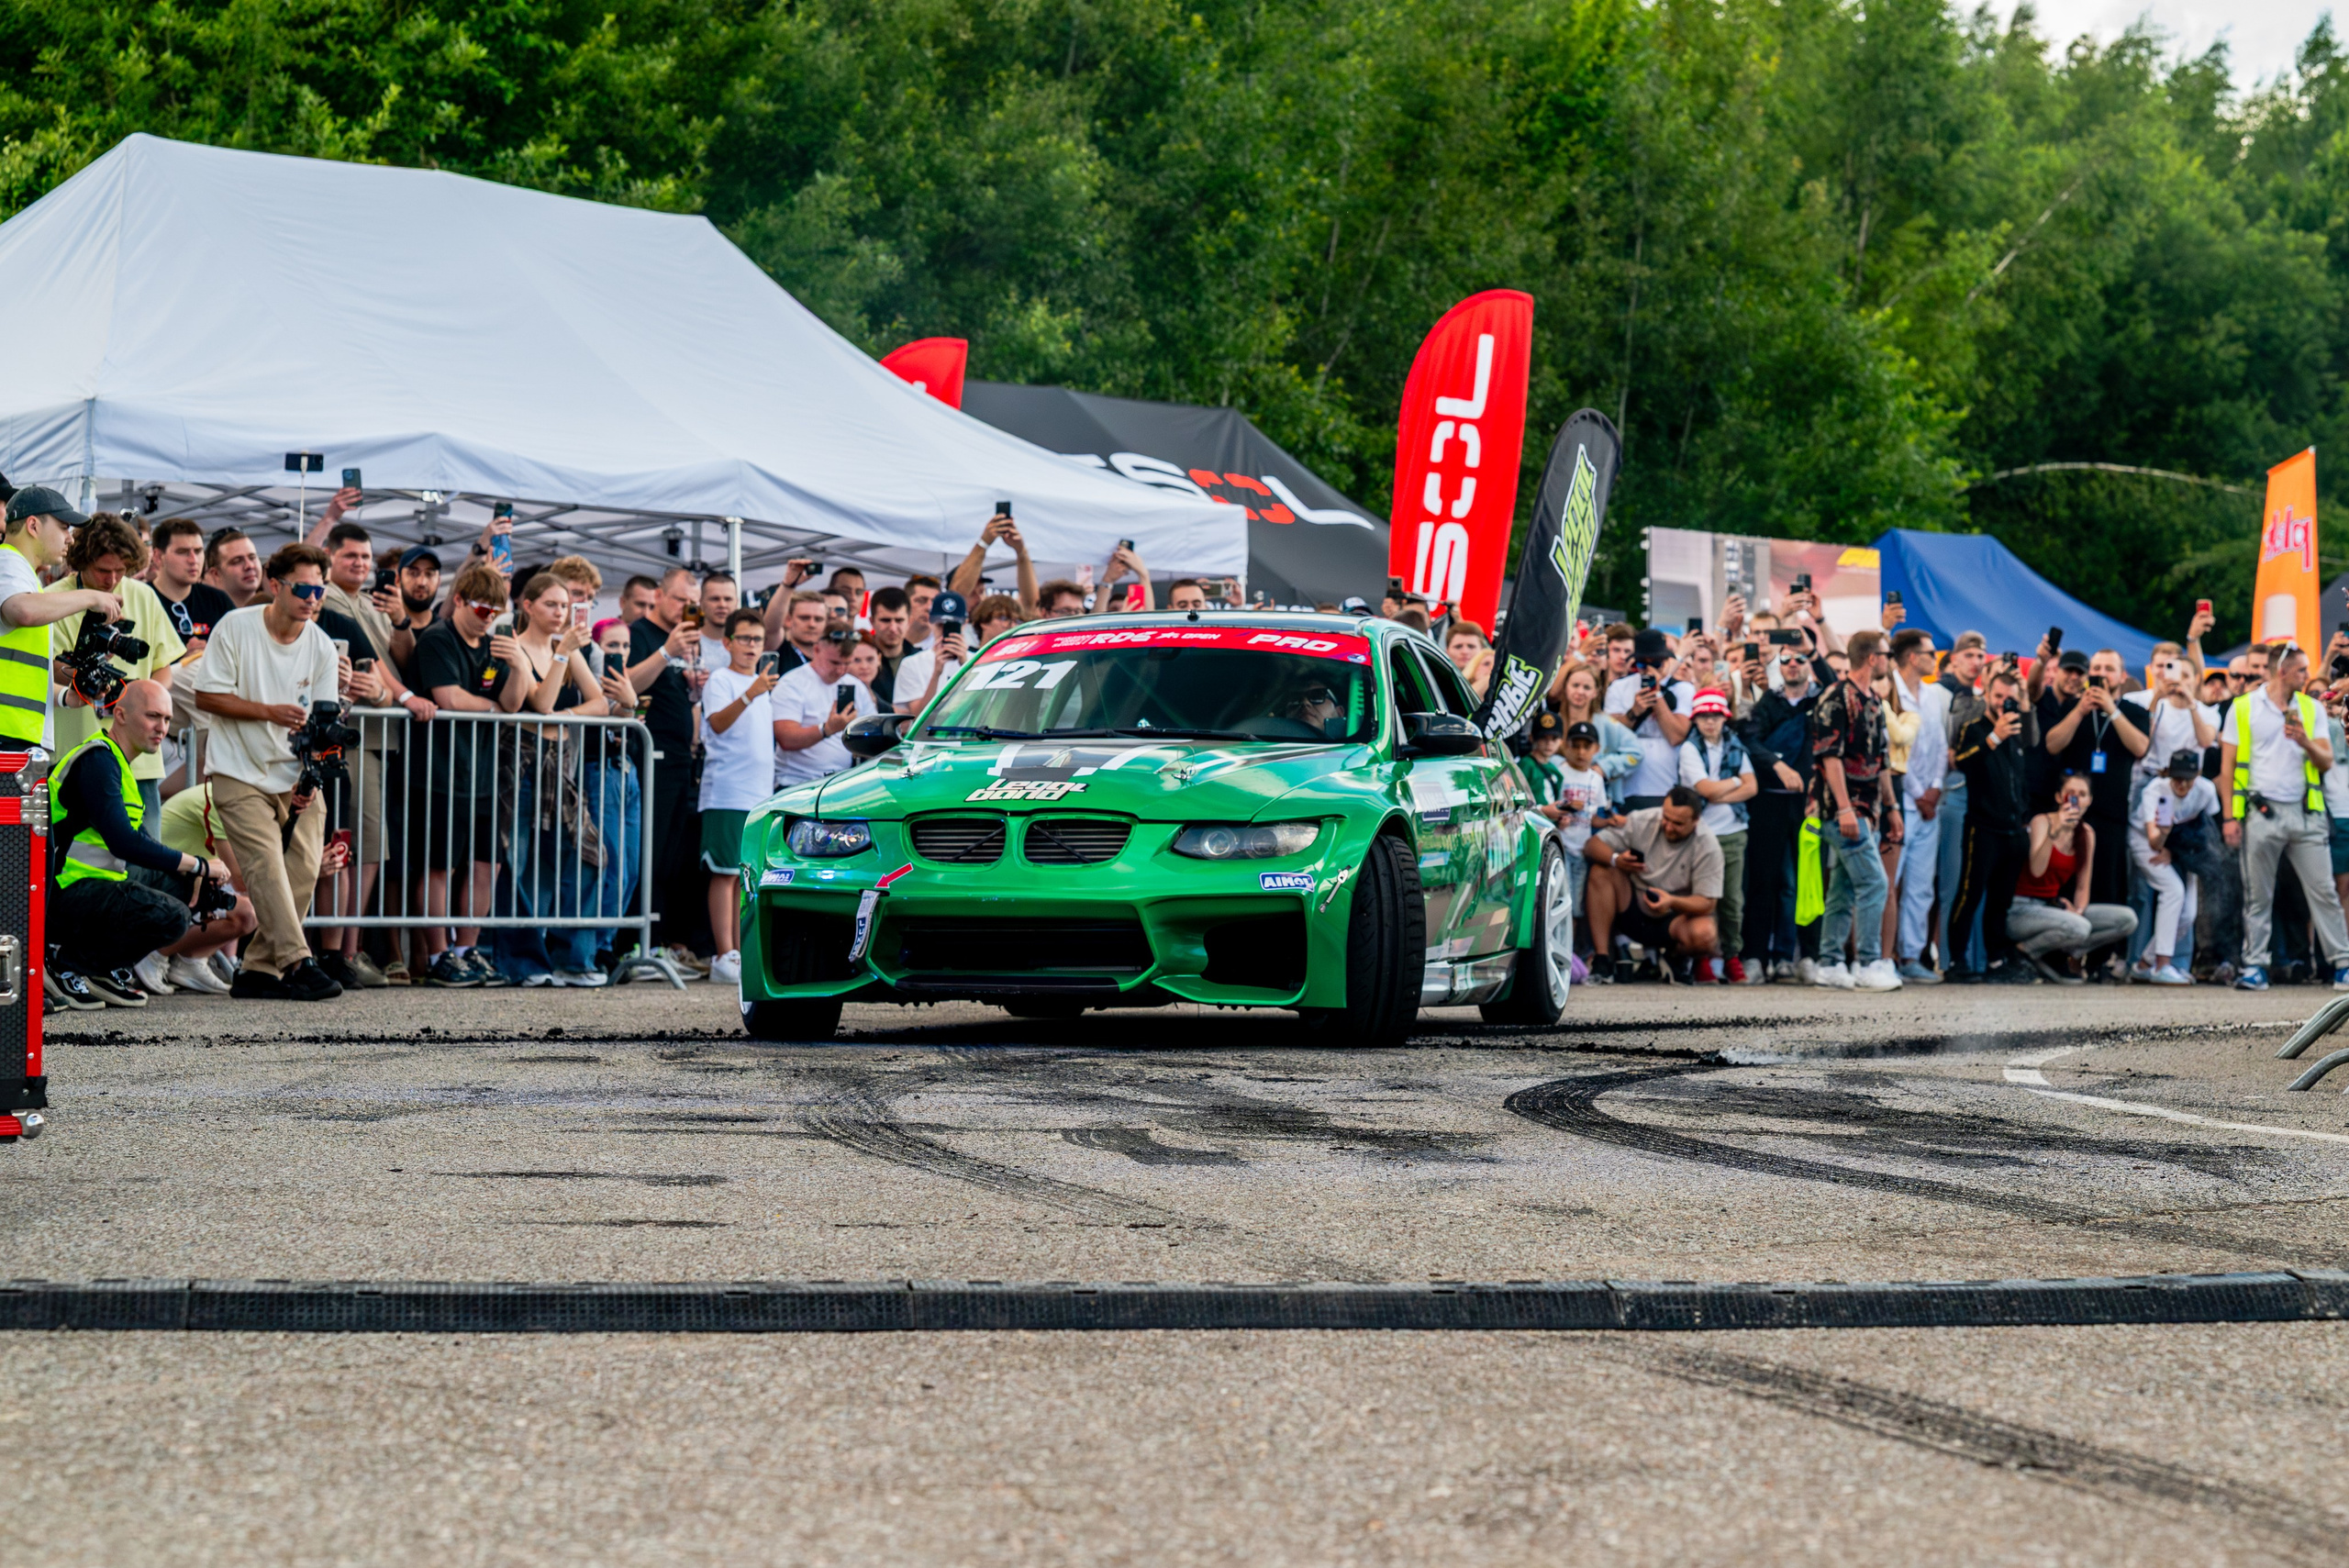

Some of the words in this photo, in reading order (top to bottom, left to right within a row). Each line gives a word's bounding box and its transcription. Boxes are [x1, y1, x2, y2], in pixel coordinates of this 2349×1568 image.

[1089, 630, 1159, 645] RDS
[1180, 632, 1222, 640] OPEN
[1246, 633, 1339, 651] PRO
[964, 660, 1078, 691] 121
